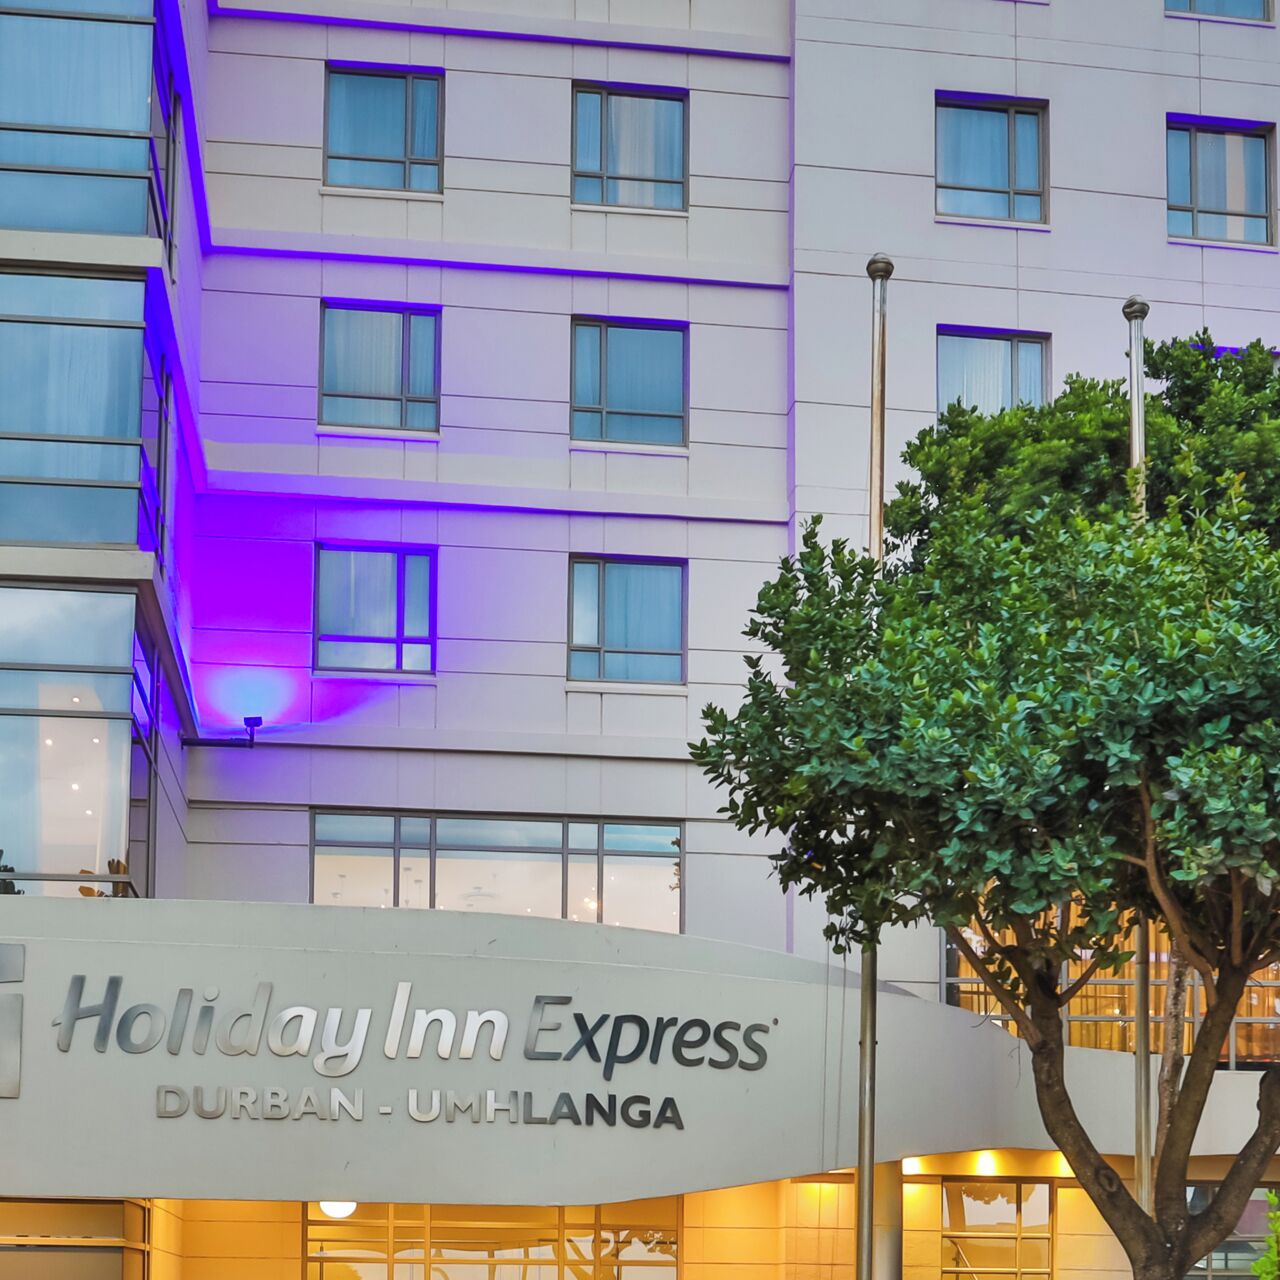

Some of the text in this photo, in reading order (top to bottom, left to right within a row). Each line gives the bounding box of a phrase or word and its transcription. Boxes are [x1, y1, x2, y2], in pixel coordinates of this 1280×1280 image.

[51, 974, 771, 1082] Holiday Inn Express
[155, 1084, 685, 1130] DURBAN - UMHLANGA
